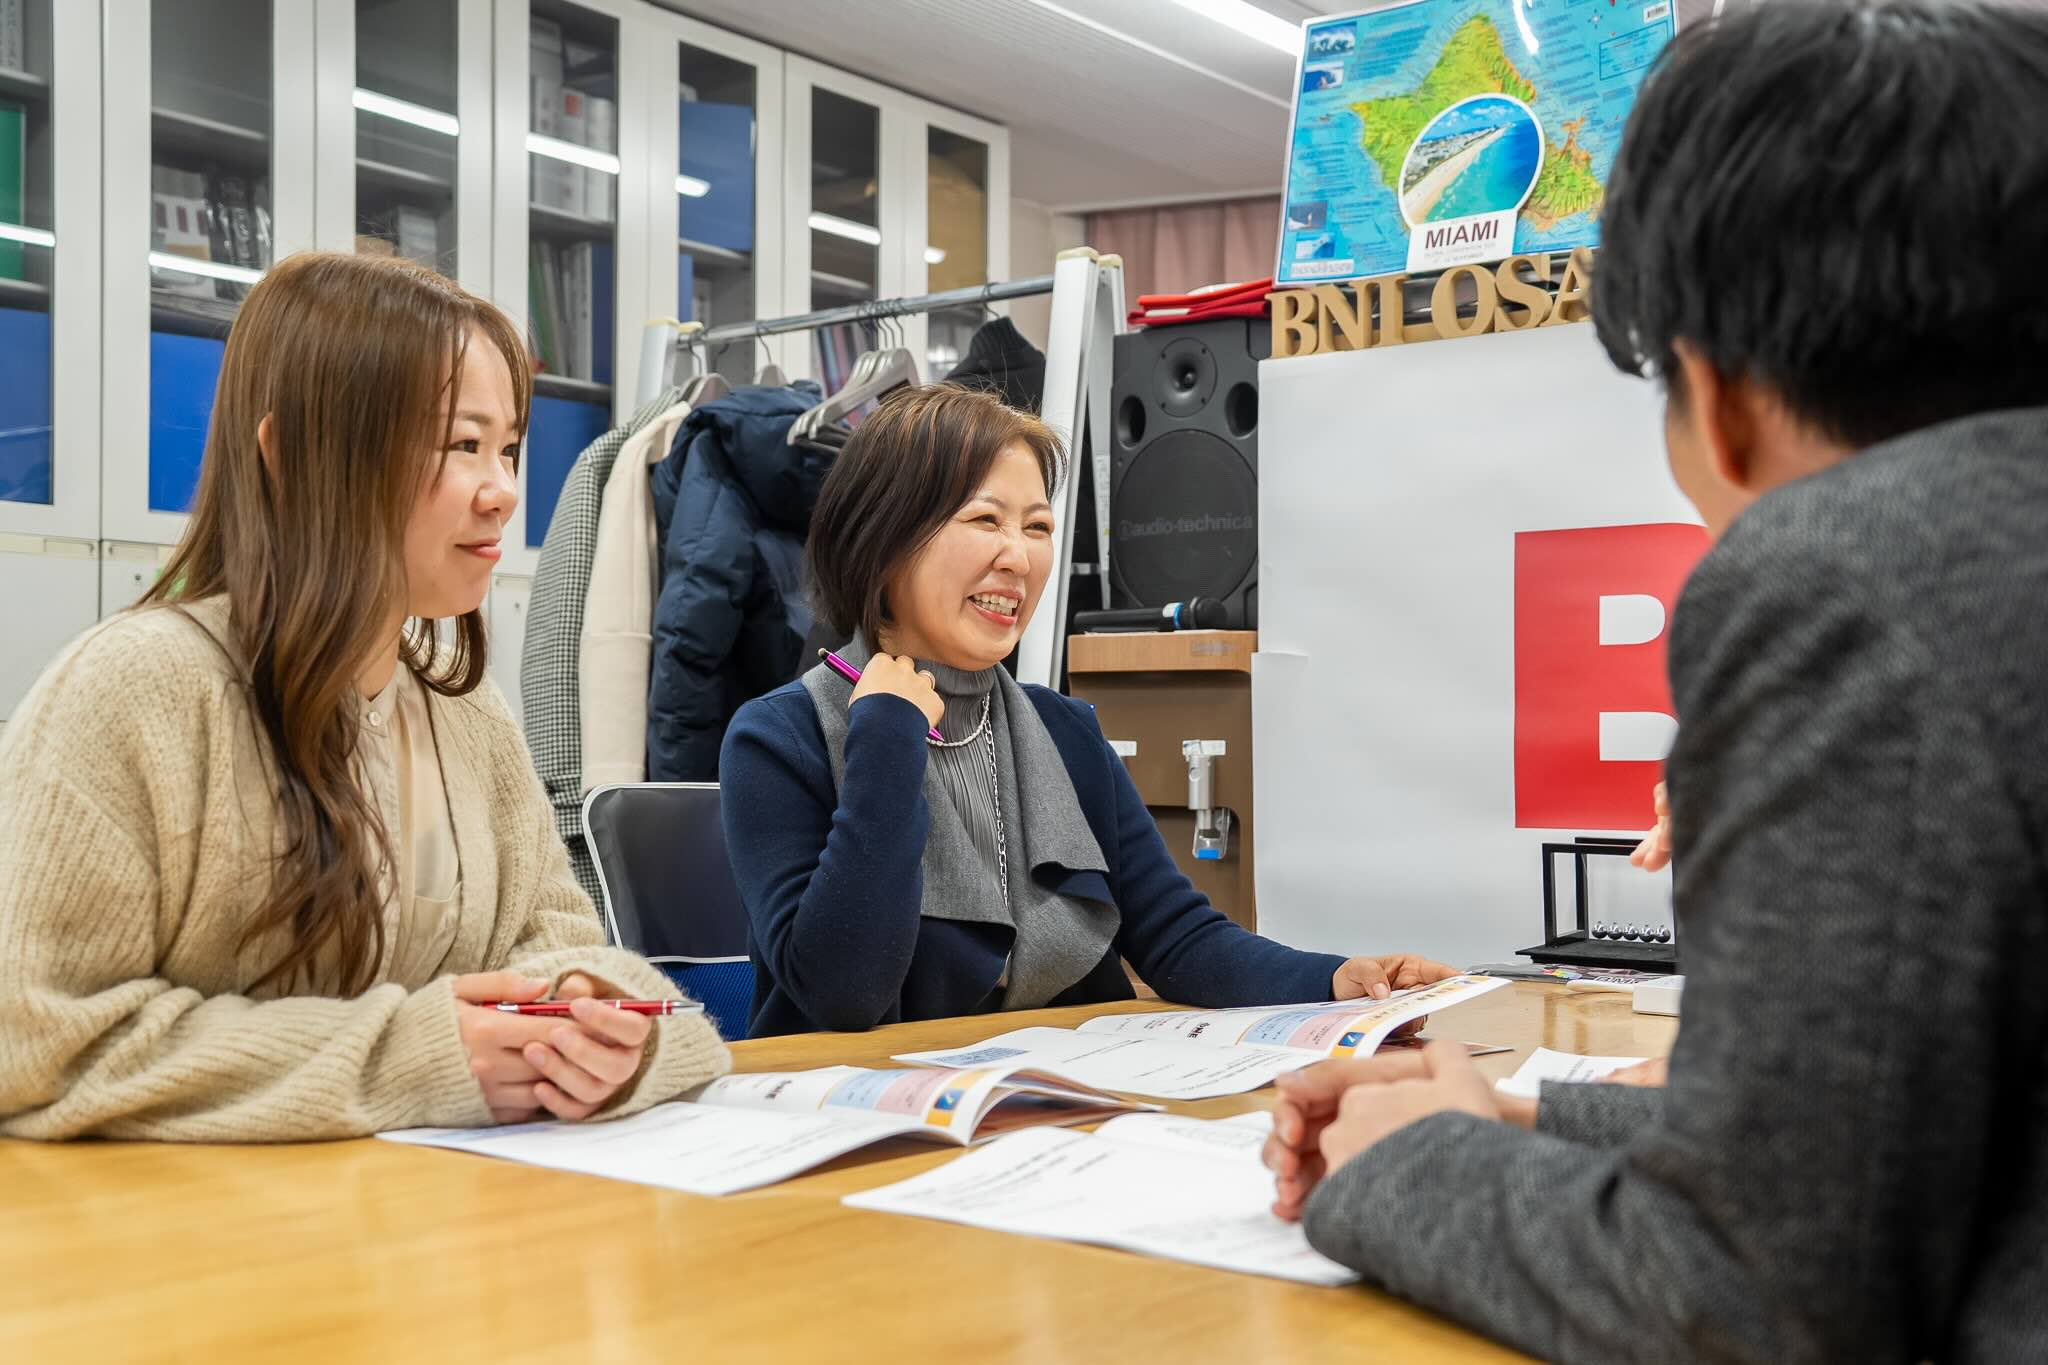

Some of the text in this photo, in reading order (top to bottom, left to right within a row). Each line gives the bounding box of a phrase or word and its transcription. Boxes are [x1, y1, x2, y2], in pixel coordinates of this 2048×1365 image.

[1425, 219, 1499, 249] MIAMI
[1265, 273, 1410, 359] BNI
[1514, 522, 1712, 831] B
